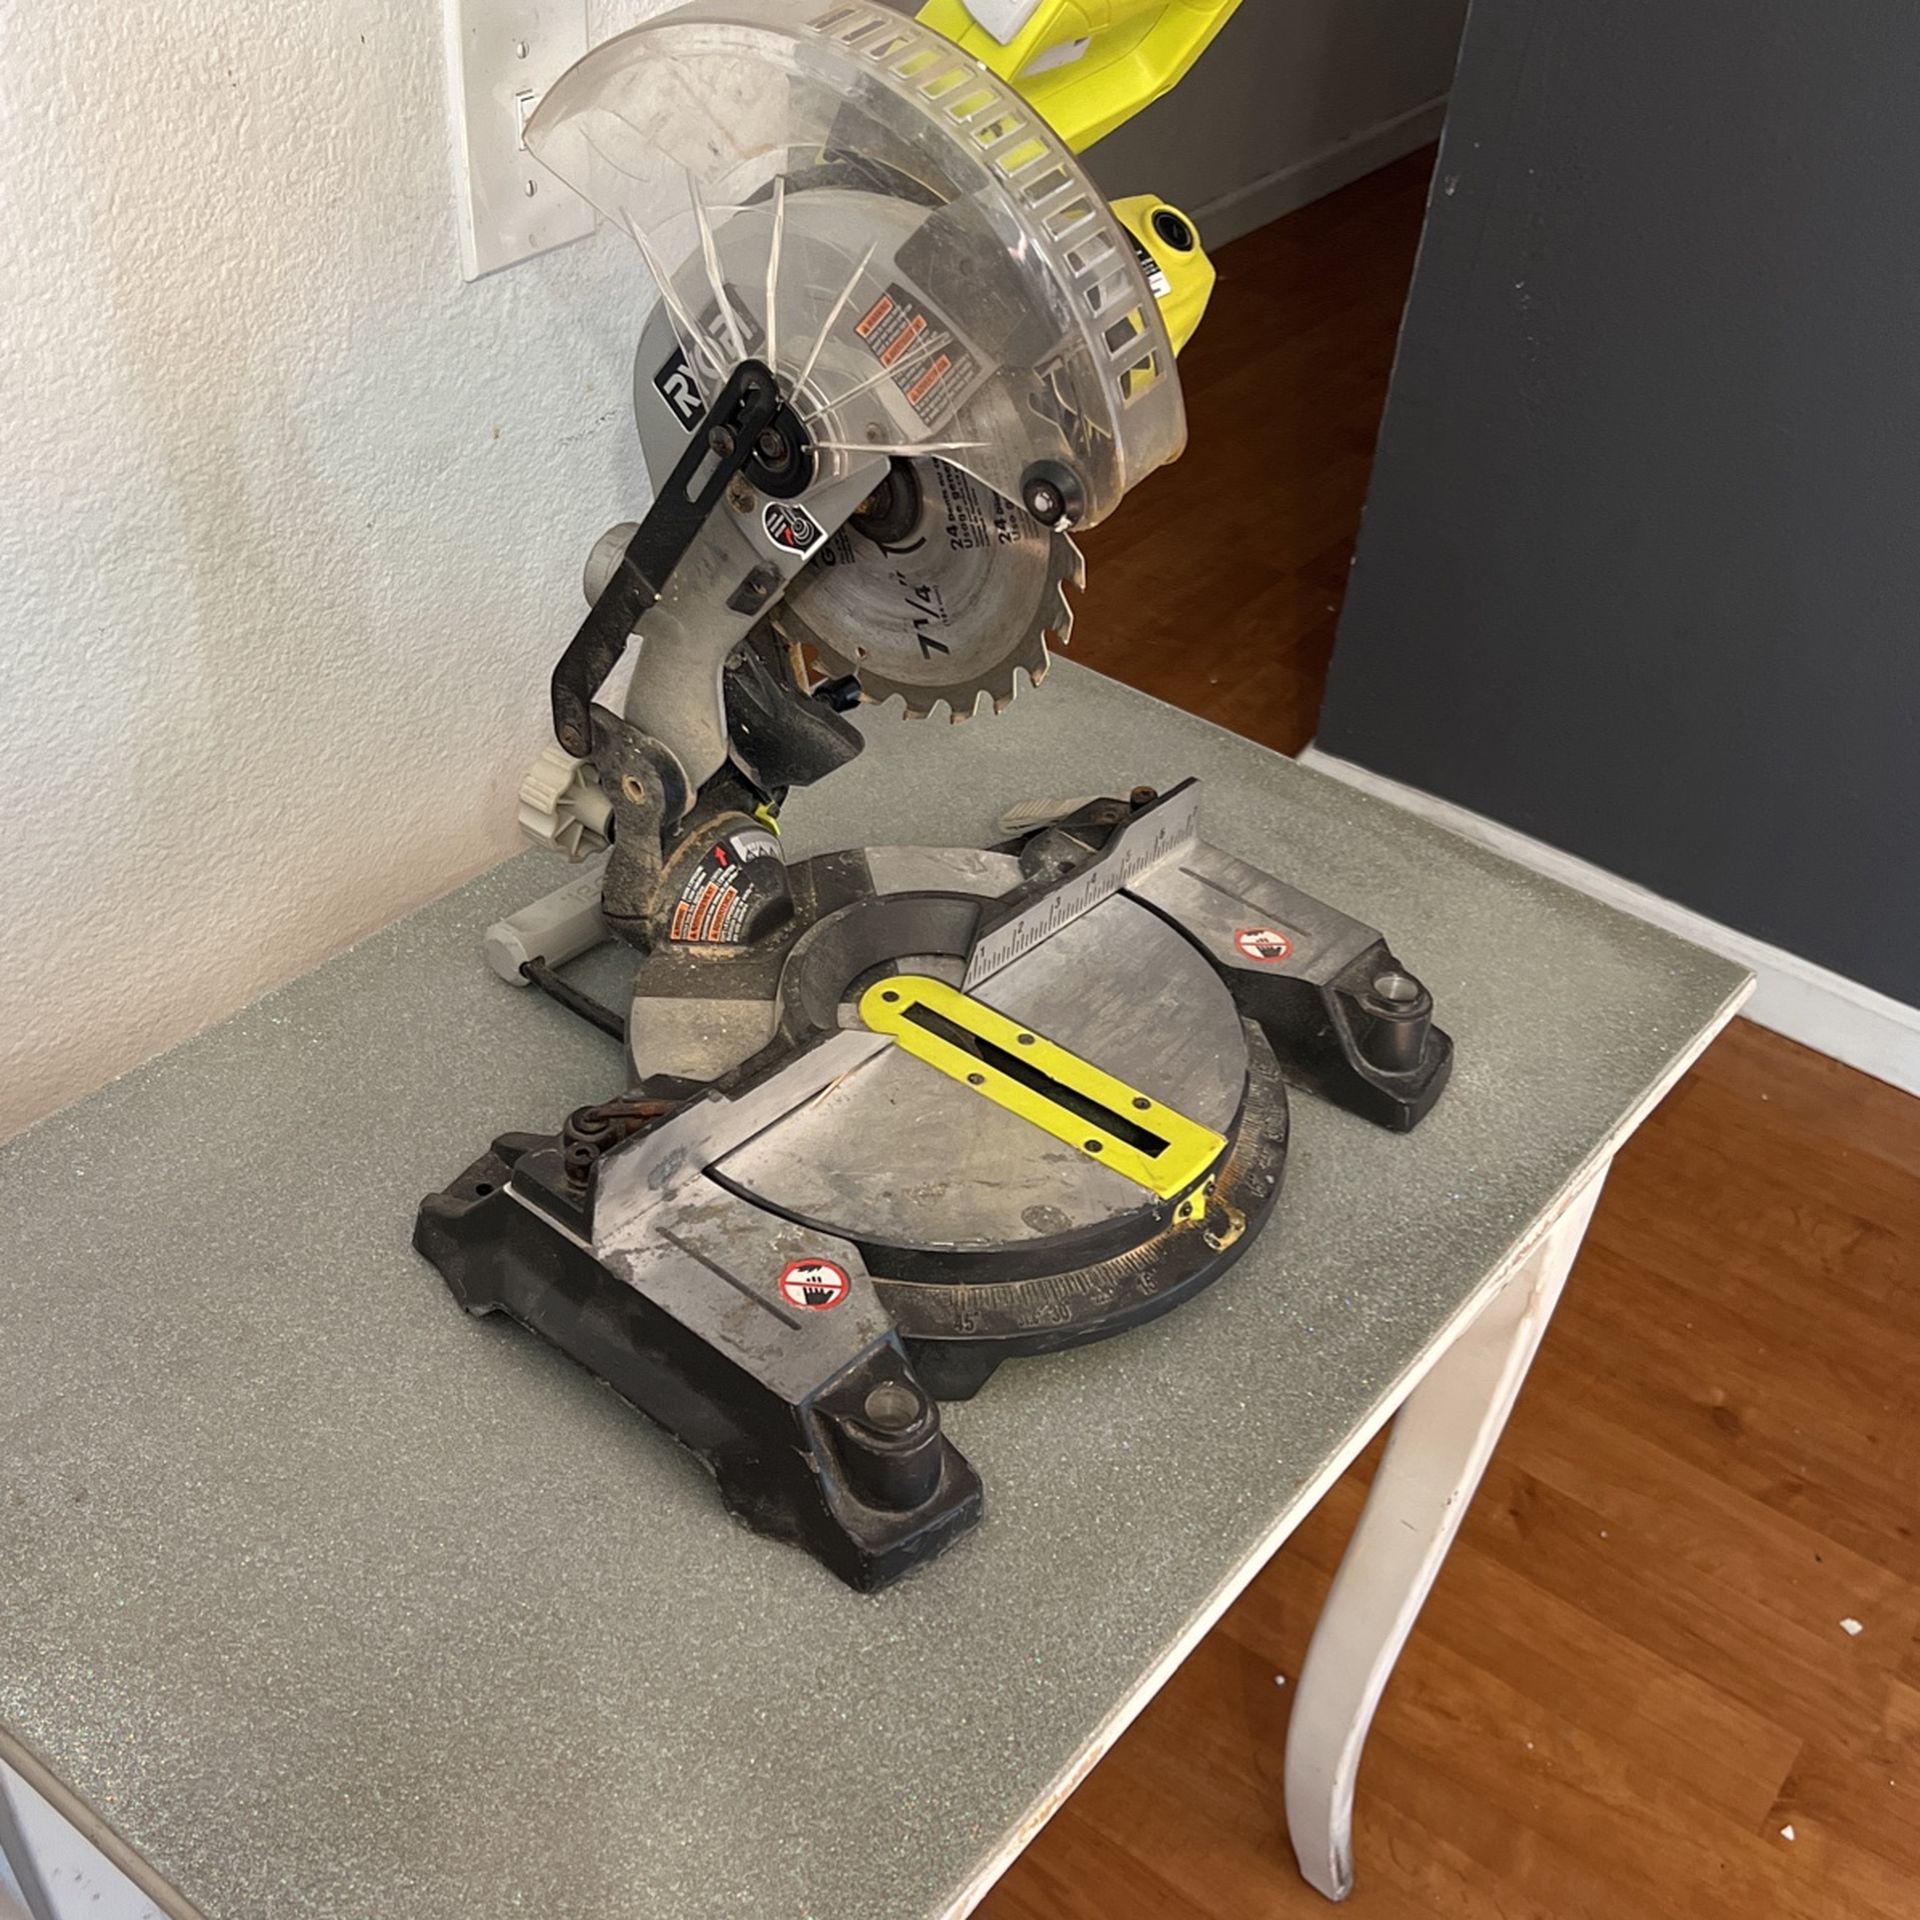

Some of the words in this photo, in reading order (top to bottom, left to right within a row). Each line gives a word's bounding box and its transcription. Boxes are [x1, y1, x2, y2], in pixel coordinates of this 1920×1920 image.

[947, 525, 963, 551] 24
[955, 505, 974, 549] Usage
[994, 520, 1011, 544] 24
[917, 633, 950, 660] 7
